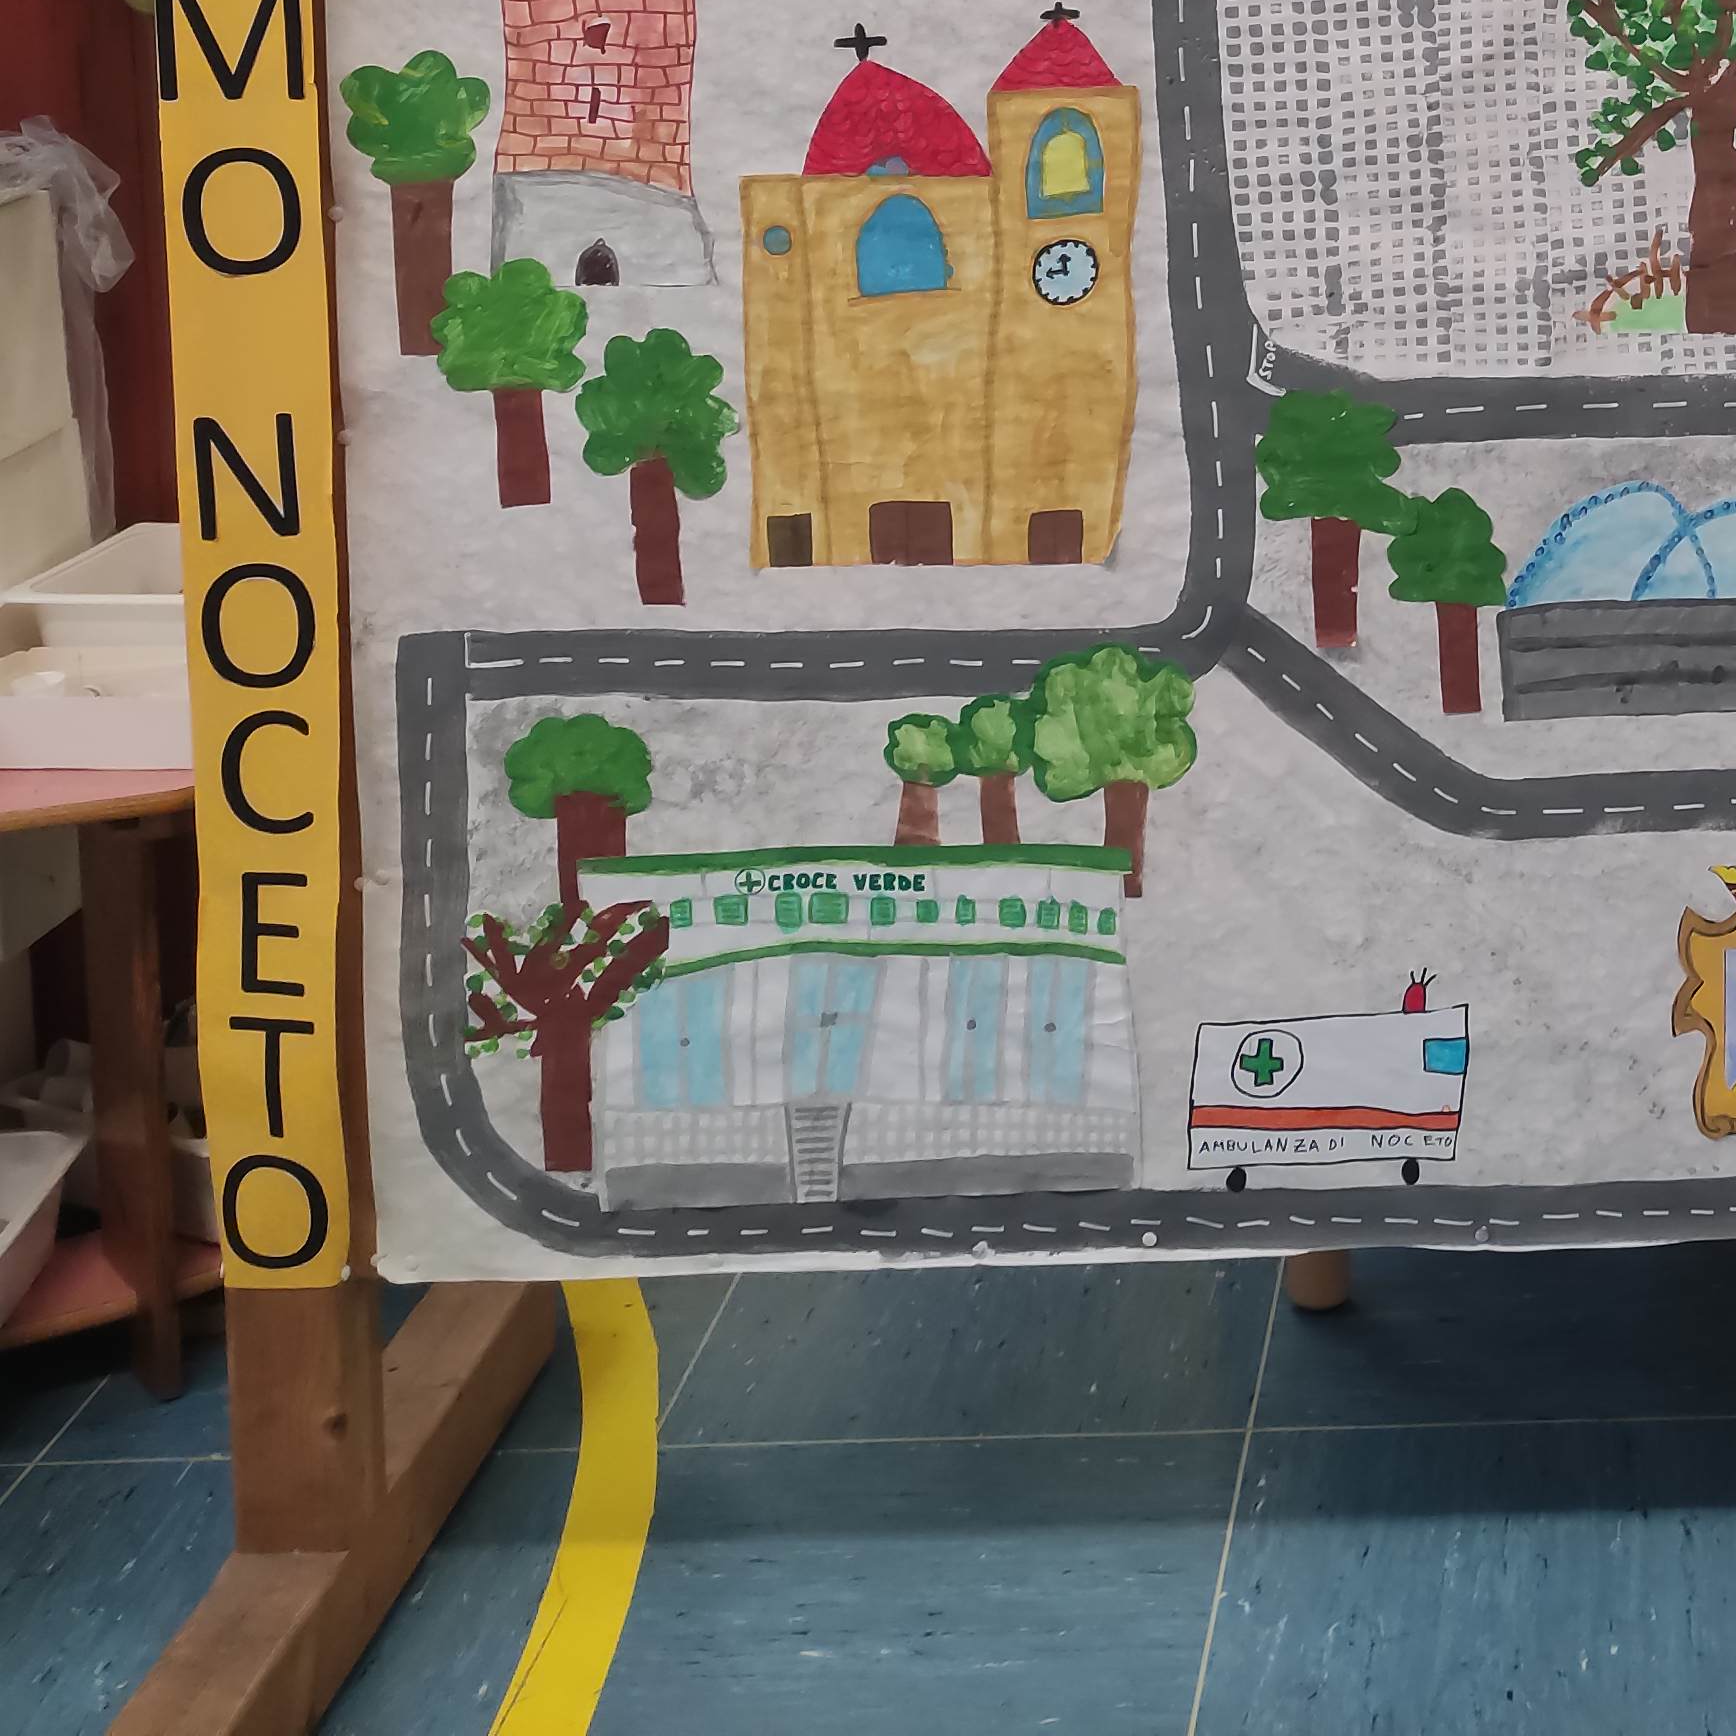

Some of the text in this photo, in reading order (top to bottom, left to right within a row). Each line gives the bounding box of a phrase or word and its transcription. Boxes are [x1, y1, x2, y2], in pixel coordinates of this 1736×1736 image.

[1258, 340, 1277, 380] STOP
[193, 412, 329, 1270] NOCETO
[767, 872, 926, 892] CROCE VERDE
[1199, 1137, 1320, 1155] AMBULANZA
[1328, 1137, 1344, 1151] DI
